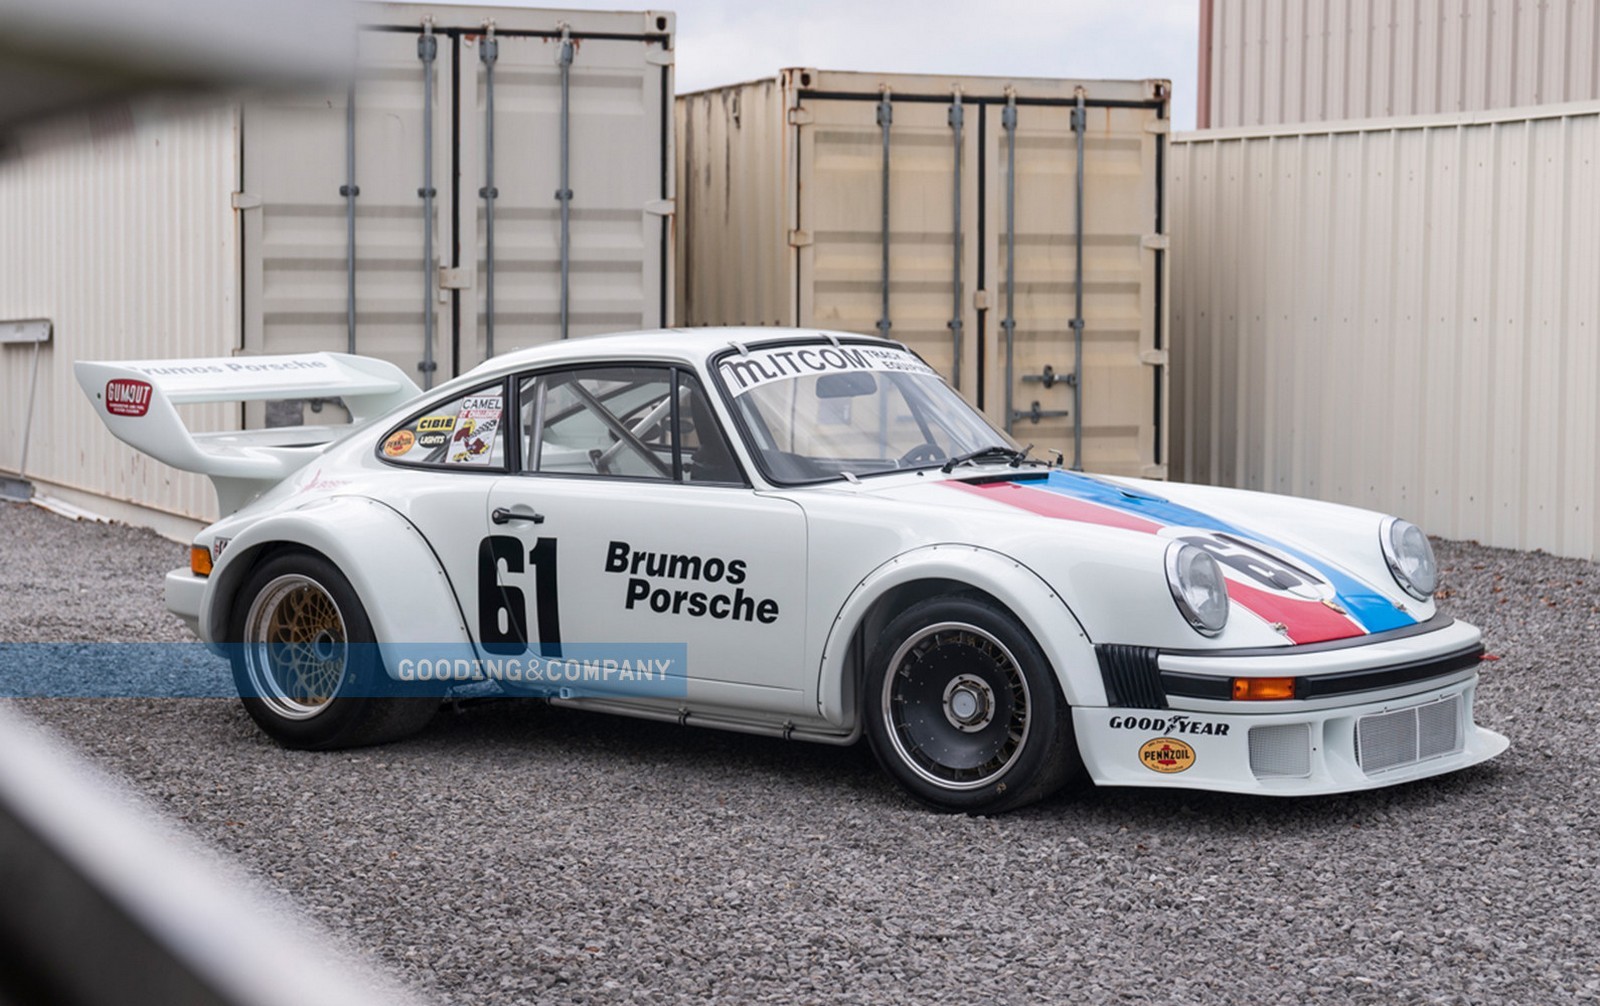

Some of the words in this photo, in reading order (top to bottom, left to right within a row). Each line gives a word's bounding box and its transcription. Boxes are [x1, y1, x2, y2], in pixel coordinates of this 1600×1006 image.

[225, 360, 328, 372] Porsche
[108, 383, 150, 404] GUMOUT
[462, 399, 502, 410] CAMEL
[419, 418, 453, 429] CIBIE
[420, 435, 445, 445] LIGHTS
[605, 541, 746, 584] Brumos
[478, 535, 563, 658] 61
[625, 578, 779, 625] Porsche
[1144, 750, 1190, 761] PENNZOIL
